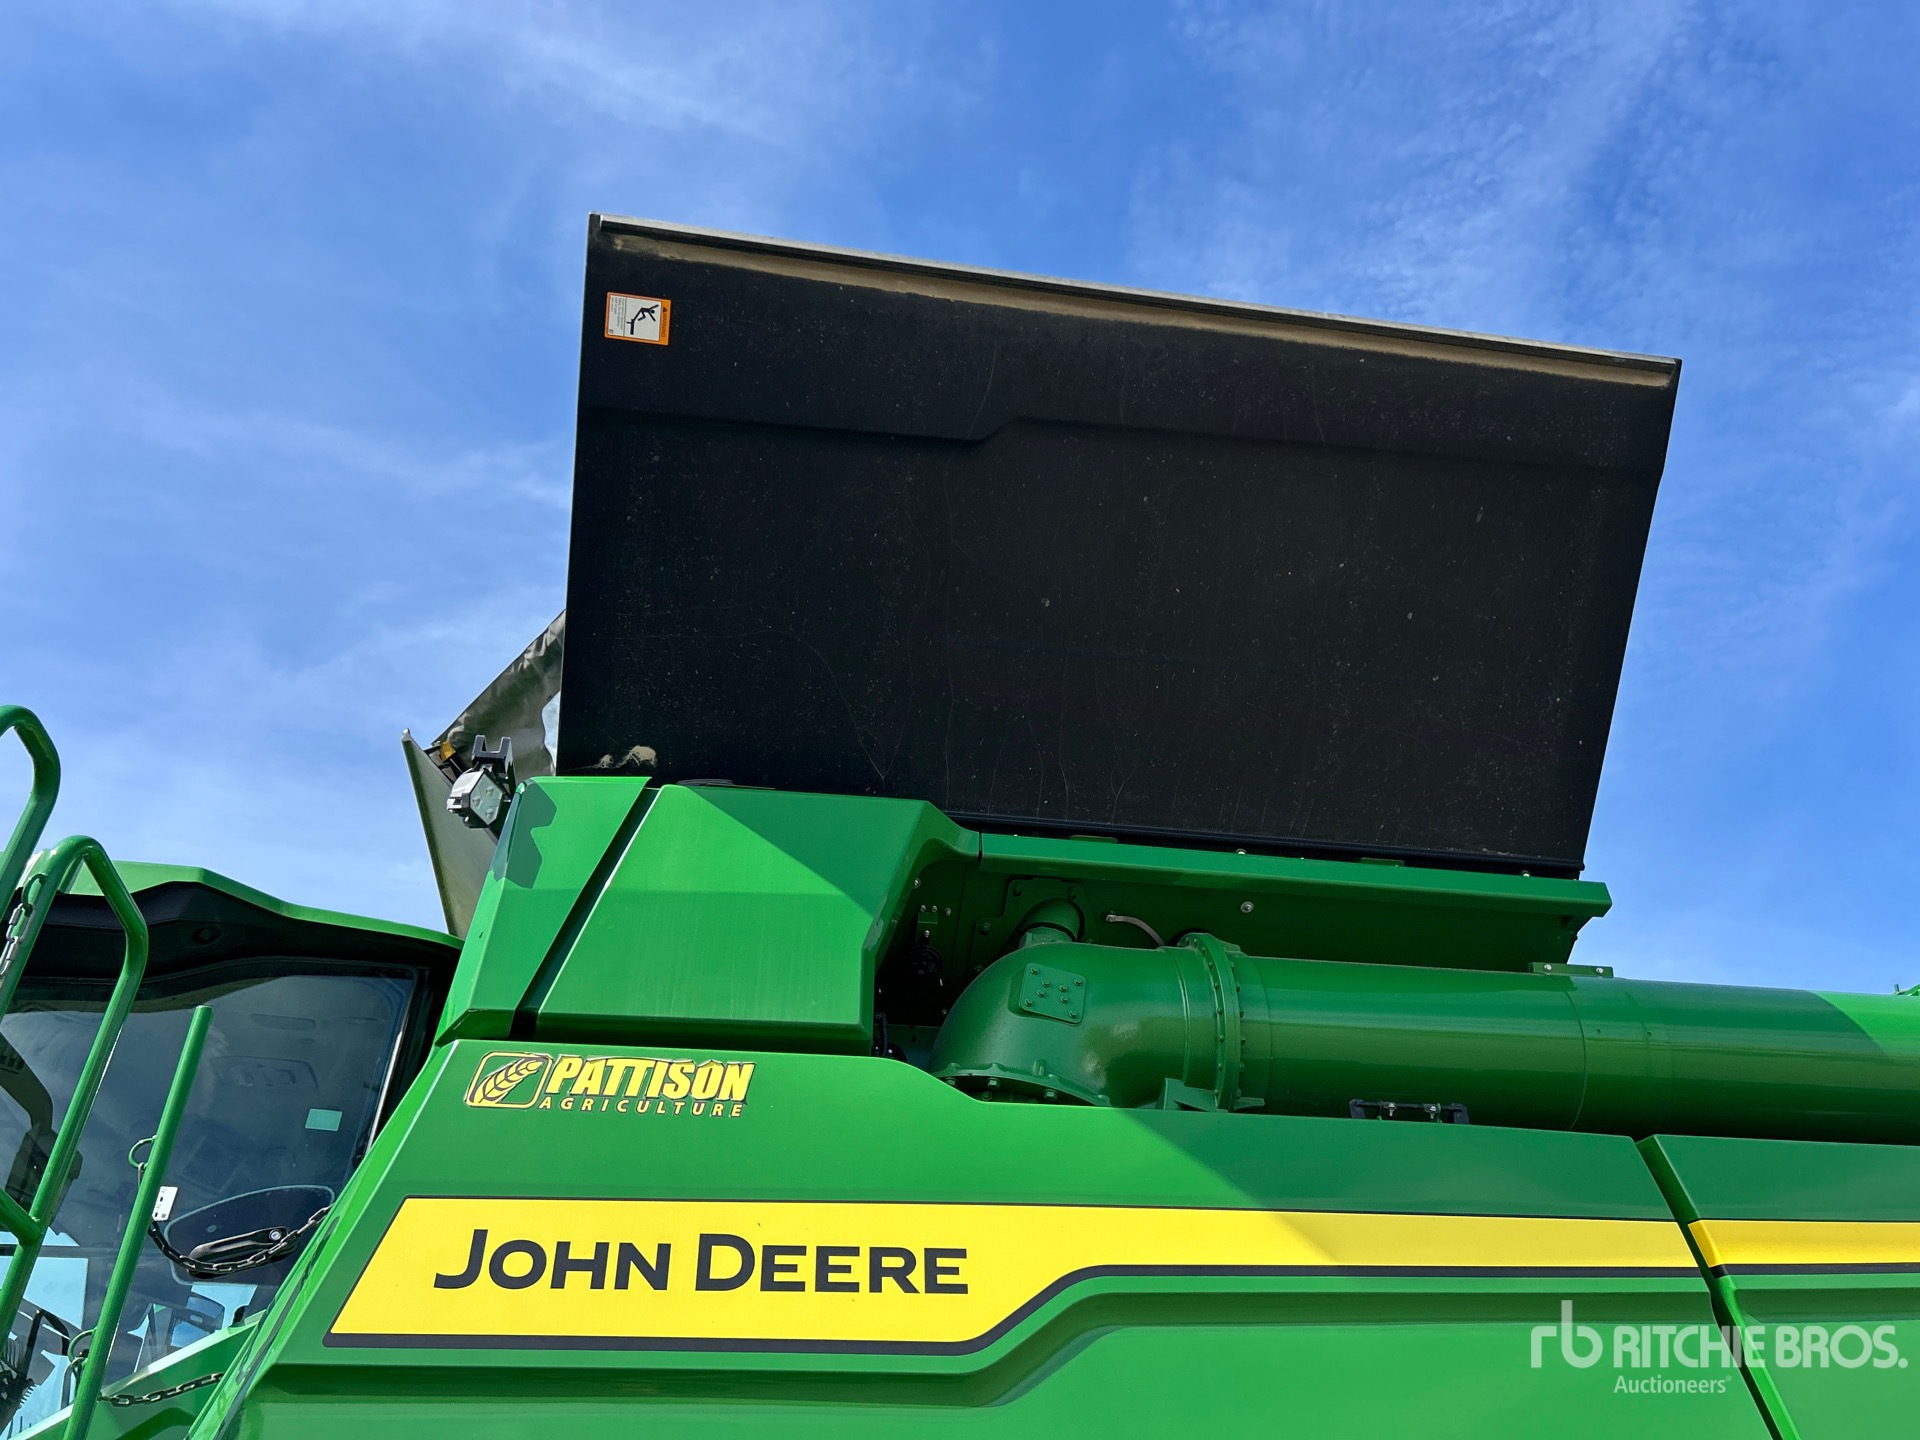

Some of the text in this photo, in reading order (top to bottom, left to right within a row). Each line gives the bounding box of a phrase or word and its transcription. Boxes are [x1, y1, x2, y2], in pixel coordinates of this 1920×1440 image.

[545, 1054, 755, 1101] PATTISON
[538, 1097, 744, 1117] AGRICULTURE
[434, 1229, 969, 1294] JOHN DEERE
